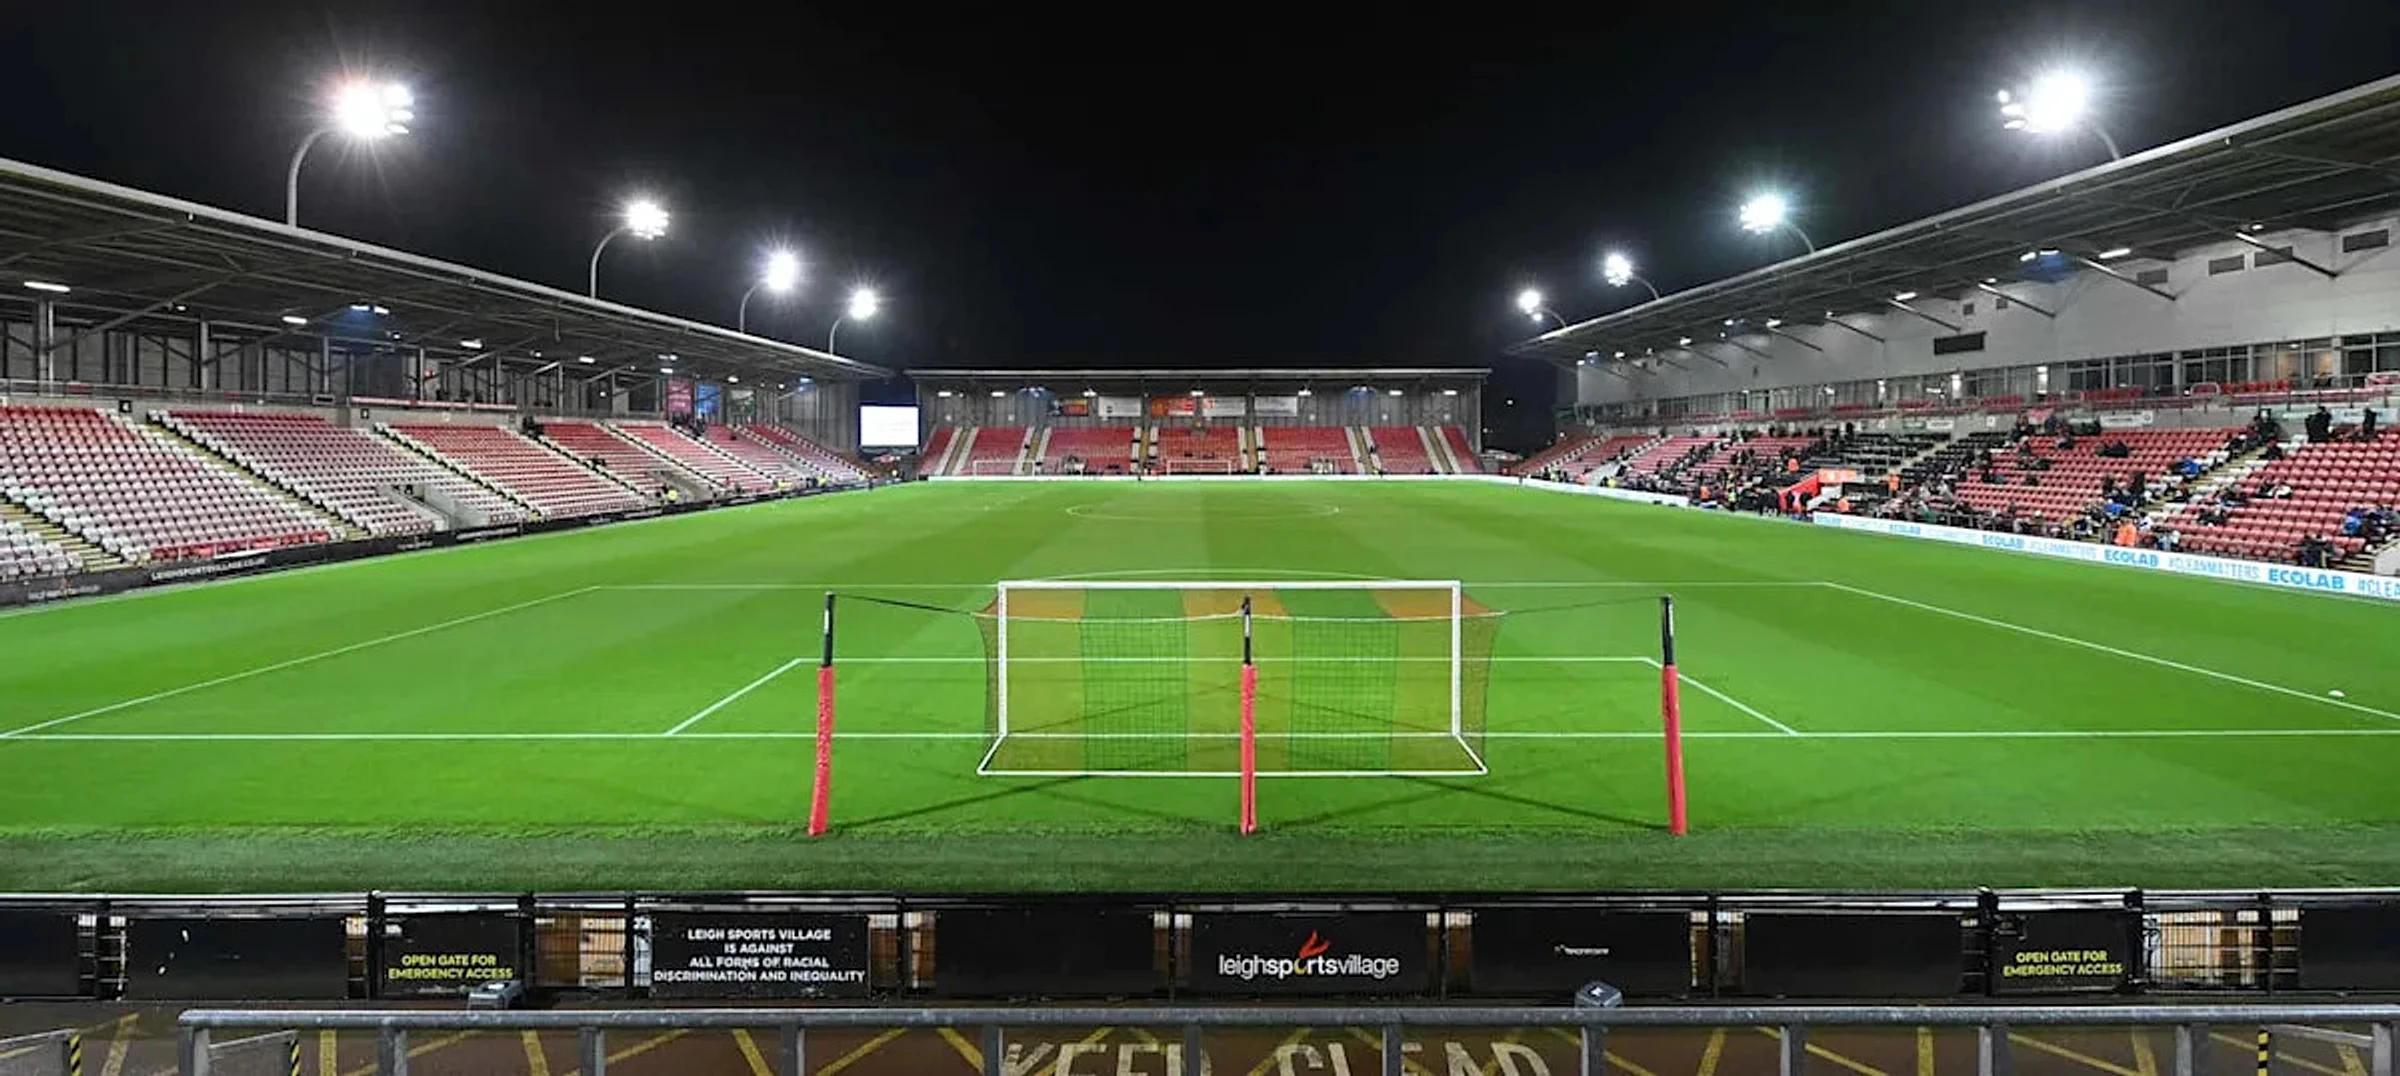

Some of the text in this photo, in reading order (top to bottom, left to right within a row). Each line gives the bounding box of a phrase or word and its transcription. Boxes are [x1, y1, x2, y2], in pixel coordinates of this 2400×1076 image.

[1982, 533, 2024, 550] ECOLAB
[2104, 549, 2160, 568] ECOLAB
[2168, 556, 2260, 580] #CLEANMATTERS
[2268, 568, 2345, 590] ECOLAB
[687, 928, 832, 941] LEIGH SPORTS VILLAGE
[724, 942, 795, 954] IS AGAINST
[402, 954, 497, 966] OPEN GATE FOR
[689, 956, 829, 968] ALL FORMS OF RACIAL
[2015, 950, 2107, 963] OPEN GATE FOR
[1218, 953, 1400, 980] leighsportsvillage
[2003, 963, 2123, 977] EMERGENCY ACCESS
[388, 967, 514, 980] EMERGENCY ACCESS
[654, 970, 865, 982] DISCRIMINATION AND INEQUALITY
